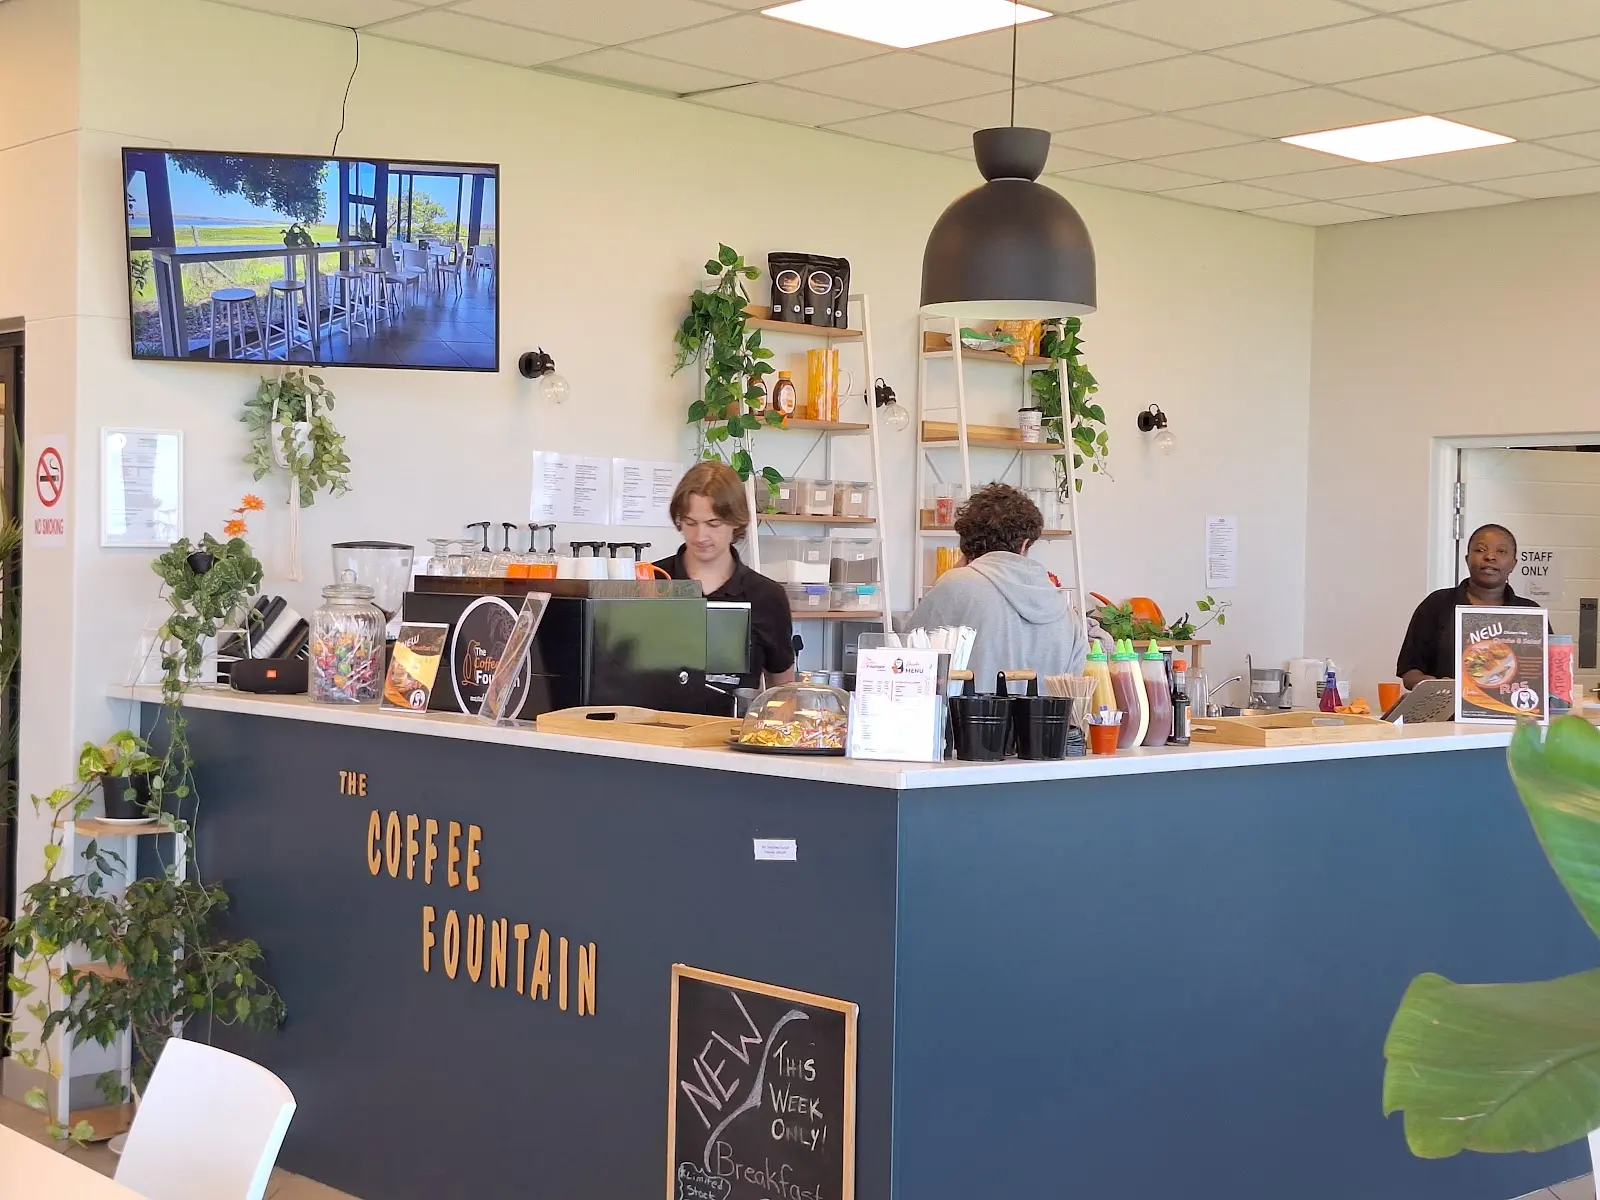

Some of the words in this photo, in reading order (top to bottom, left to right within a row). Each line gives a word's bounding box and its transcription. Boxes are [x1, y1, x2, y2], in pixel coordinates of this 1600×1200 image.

[34, 518, 41, 535] NO
[42, 518, 64, 535] SMOKING
[1521, 551, 1553, 562] STAFF
[1521, 566, 1549, 576] ONLY
[402, 634, 420, 648] NEW
[1469, 621, 1503, 645] NEW
[475, 647, 486, 657] The
[339, 770, 368, 797] THE
[367, 809, 482, 892] COFFEE
[422, 905, 597, 1017] FOUNTAIN
[680, 991, 763, 1130] NEW
[772, 1040, 817, 1082] THIS
[768, 1081, 825, 1122] WEEK
[771, 1118, 828, 1156] ONLY!
[716, 1140, 824, 1200] Breakfast
